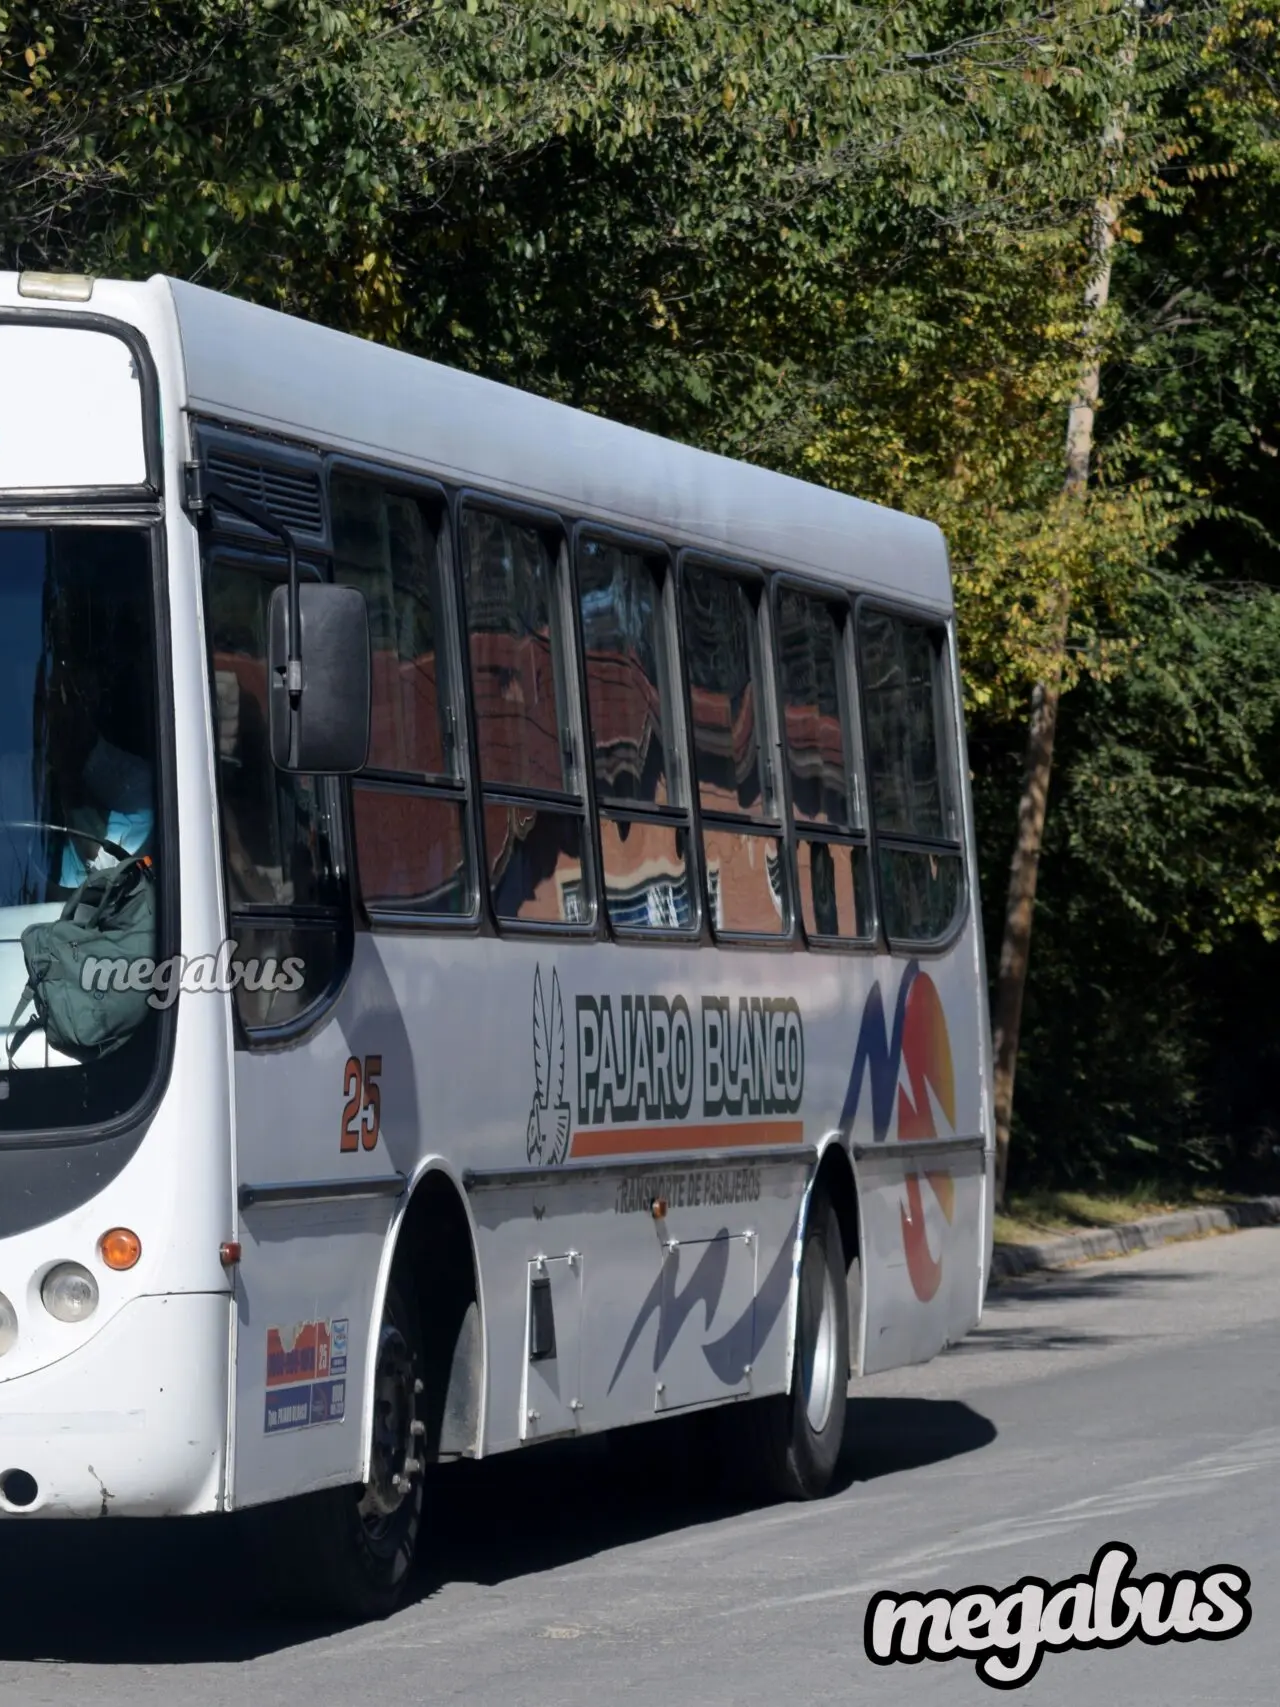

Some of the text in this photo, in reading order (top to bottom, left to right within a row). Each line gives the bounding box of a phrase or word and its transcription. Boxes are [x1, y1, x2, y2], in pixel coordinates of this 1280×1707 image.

[575, 994, 805, 1125] PAJARO BLANCO
[340, 1055, 382, 1154] 25
[687, 1173, 702, 1207] DE
[704, 1168, 761, 1206] PASAJEROS
[319, 1343, 328, 1371] 25
